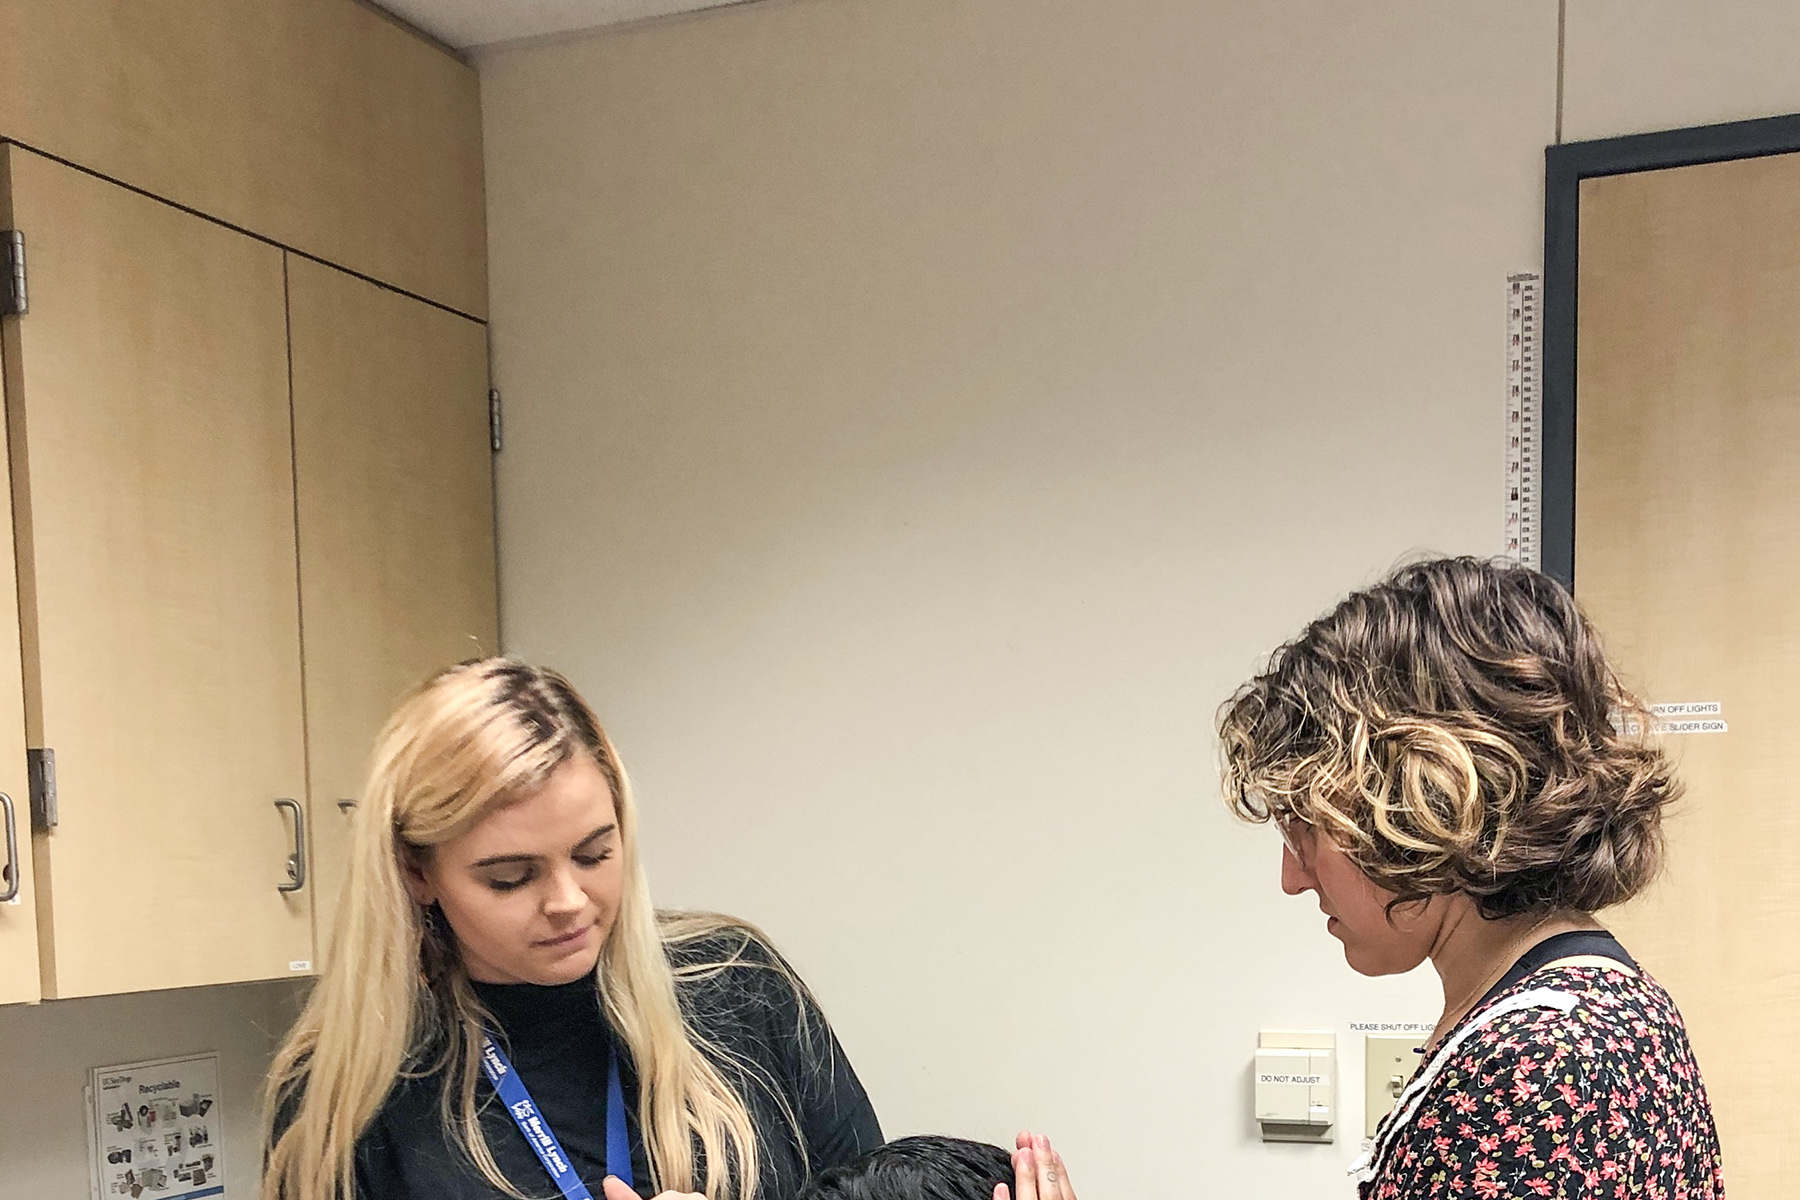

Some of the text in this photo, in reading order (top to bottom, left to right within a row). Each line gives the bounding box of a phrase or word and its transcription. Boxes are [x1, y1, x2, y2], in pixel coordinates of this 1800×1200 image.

[1667, 705, 1685, 713] OFF
[1687, 704, 1718, 713] LIGHTS
[1669, 722, 1700, 731] SLIDER
[1702, 722, 1724, 731] SIGN
[1350, 1023, 1436, 1031] PLEASE SHUT OFF LIG
[485, 1046, 508, 1075] Lynch
[139, 1080, 180, 1094] Recyclable
[527, 1116, 569, 1173] Merrill Lynch
